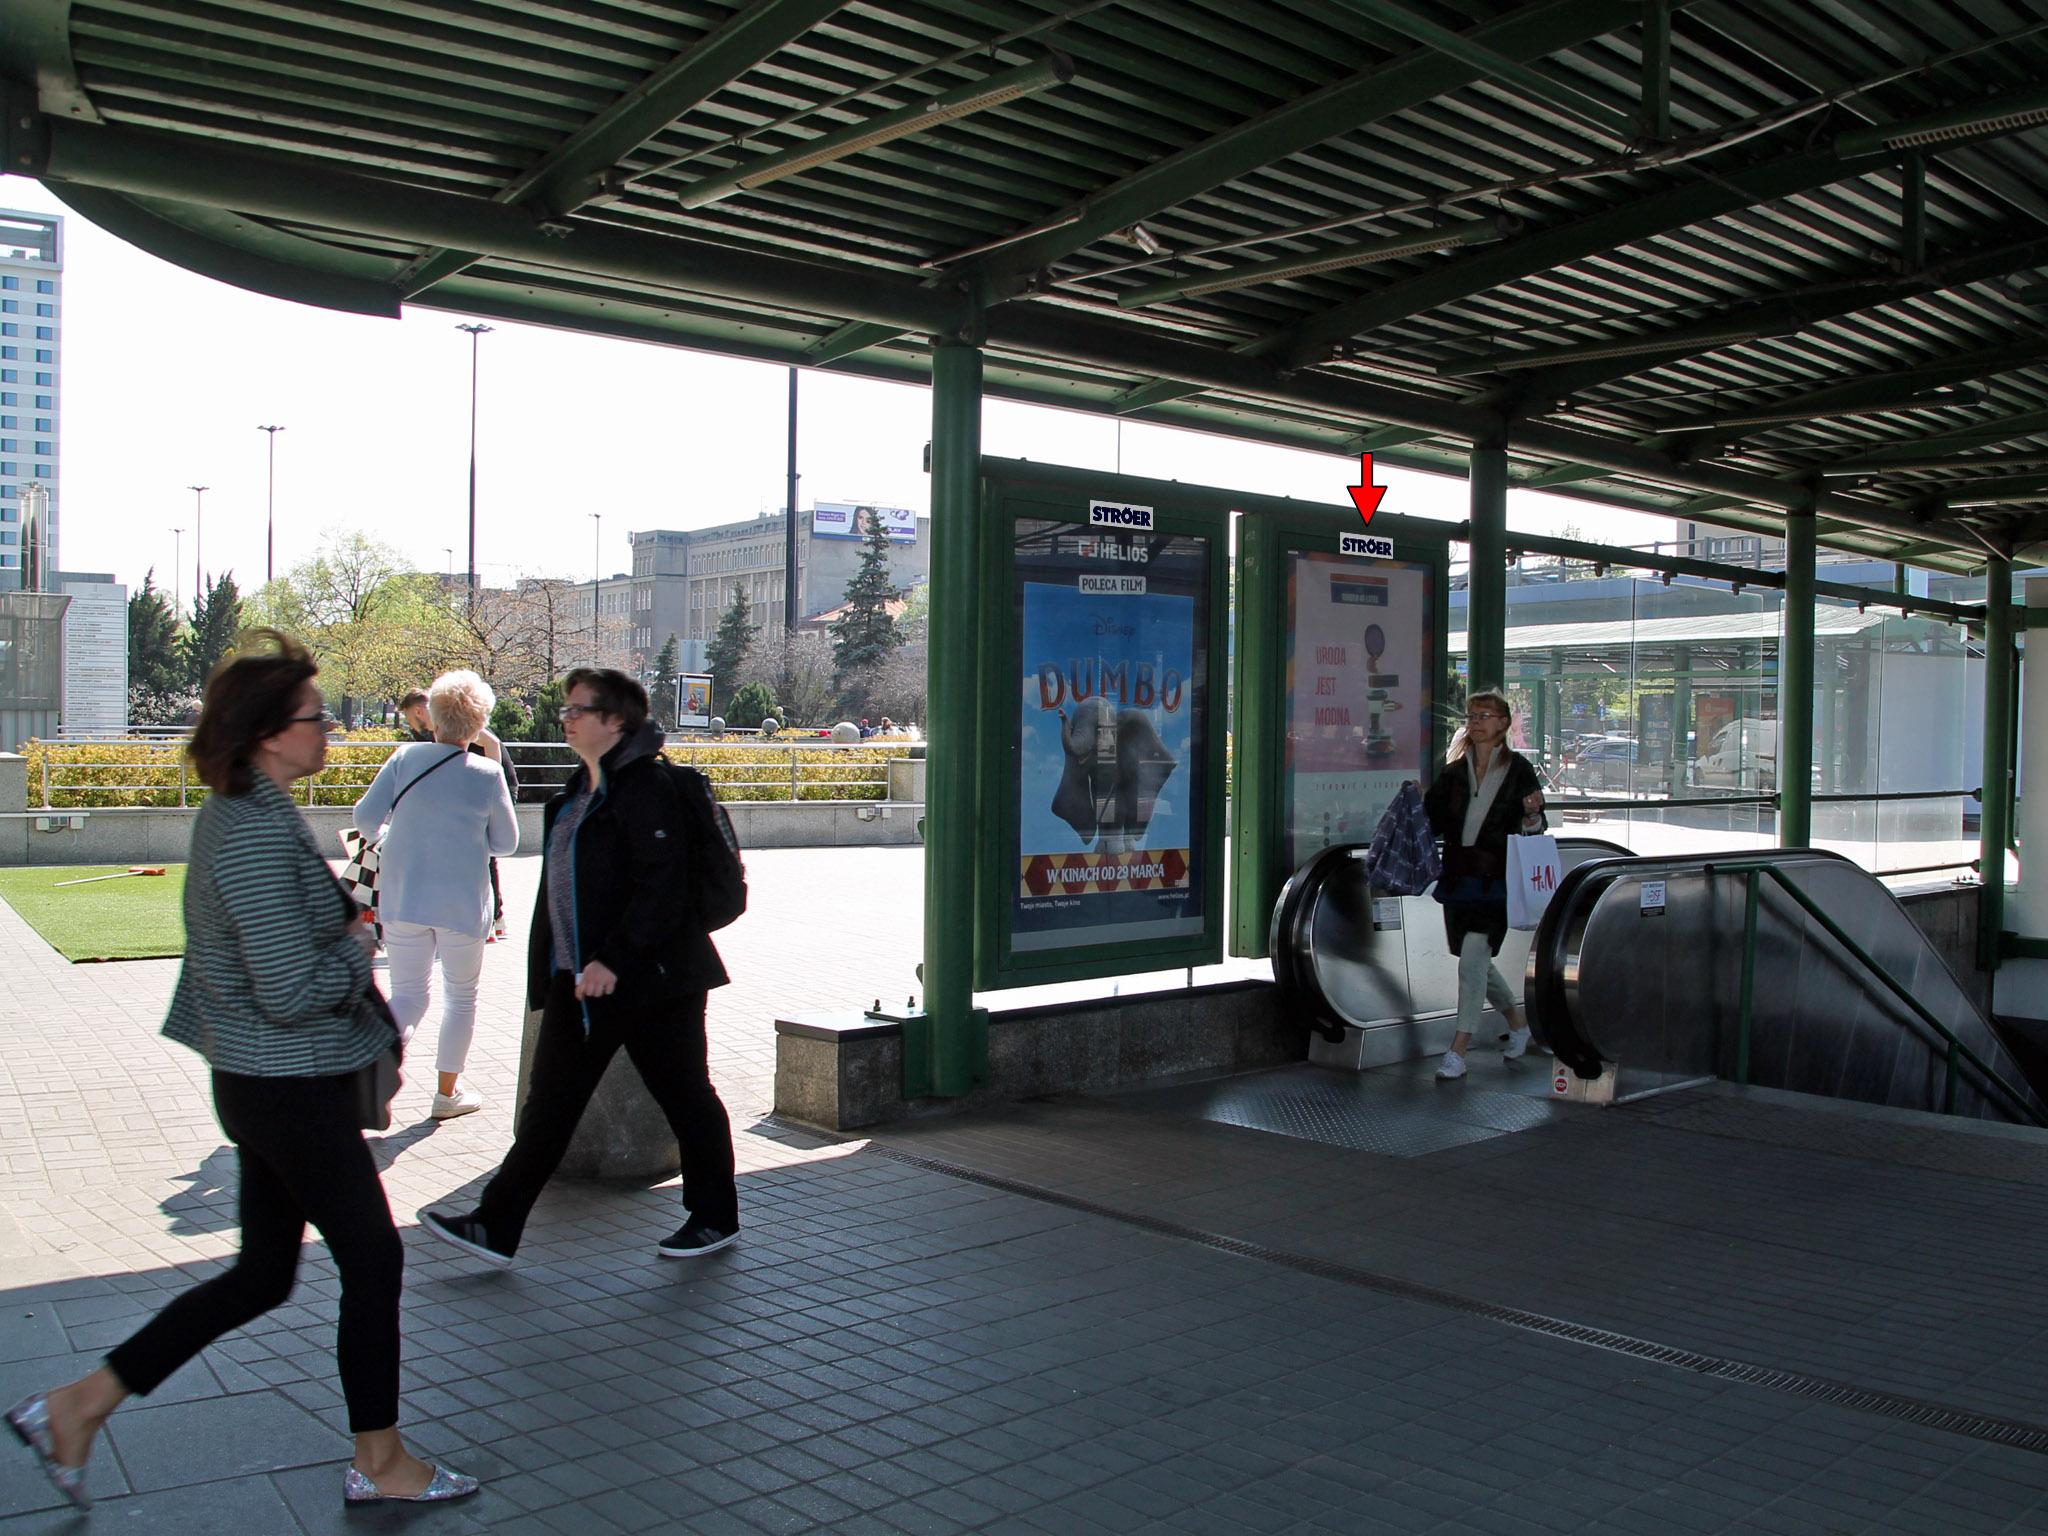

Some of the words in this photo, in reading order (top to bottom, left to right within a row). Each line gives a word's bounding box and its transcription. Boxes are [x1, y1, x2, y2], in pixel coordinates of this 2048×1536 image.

[1091, 505, 1152, 527] STRÖER
[1100, 542, 1149, 564] HELIOS
[1342, 536, 1393, 557] STRÖER
[1082, 577, 1118, 591] POLECA
[1120, 579, 1144, 592] FILM
[1316, 646, 1347, 666] URODA
[1038, 656, 1183, 713] DUMBO
[1315, 676, 1337, 696] JEST
[1314, 706, 1351, 727] MODNA
[1046, 868, 1059, 884] W
[1061, 865, 1100, 883] KINACH
[1101, 865, 1116, 880] OD
[1117, 865, 1129, 880] 29
[1130, 863, 1166, 879] MARCA
